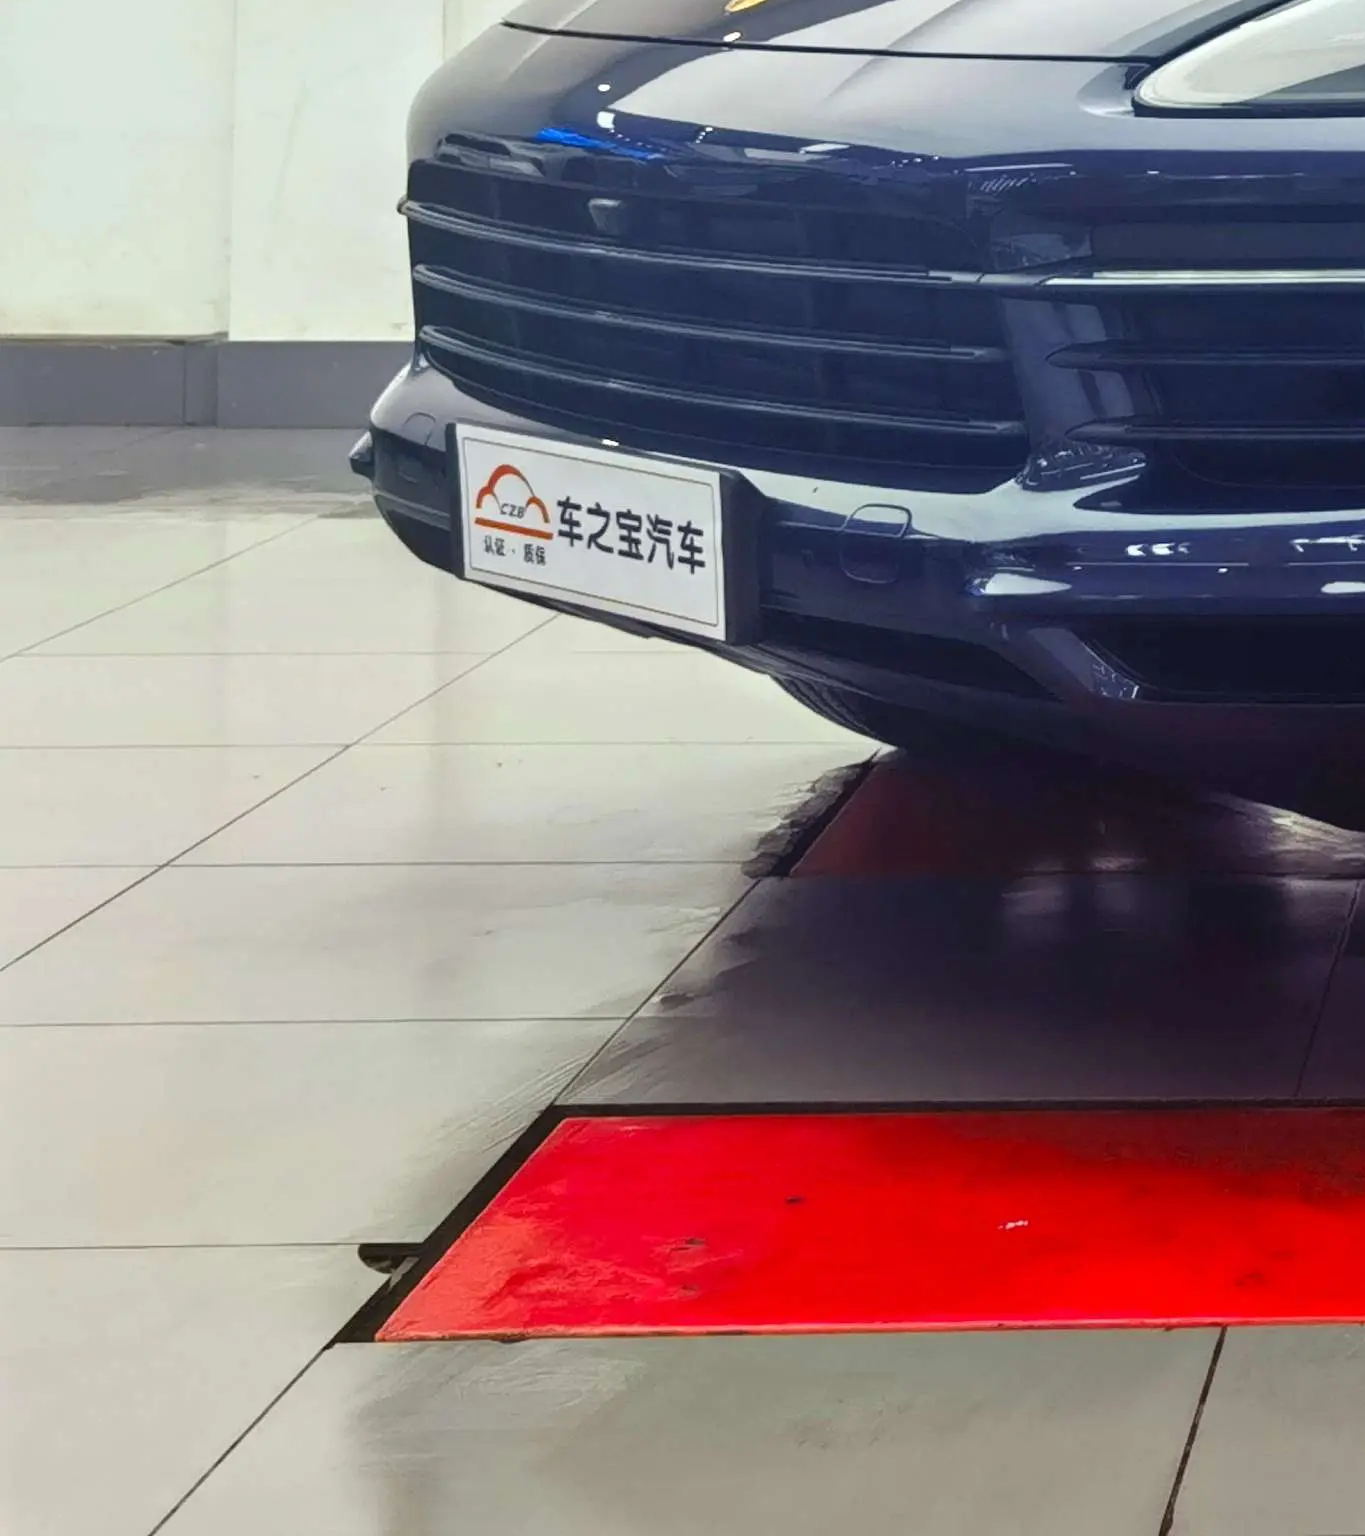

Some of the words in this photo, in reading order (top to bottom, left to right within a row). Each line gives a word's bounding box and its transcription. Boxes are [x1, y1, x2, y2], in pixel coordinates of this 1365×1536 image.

[500, 501, 525, 520] CZB
[556, 496, 705, 574] 车之宝汽车
